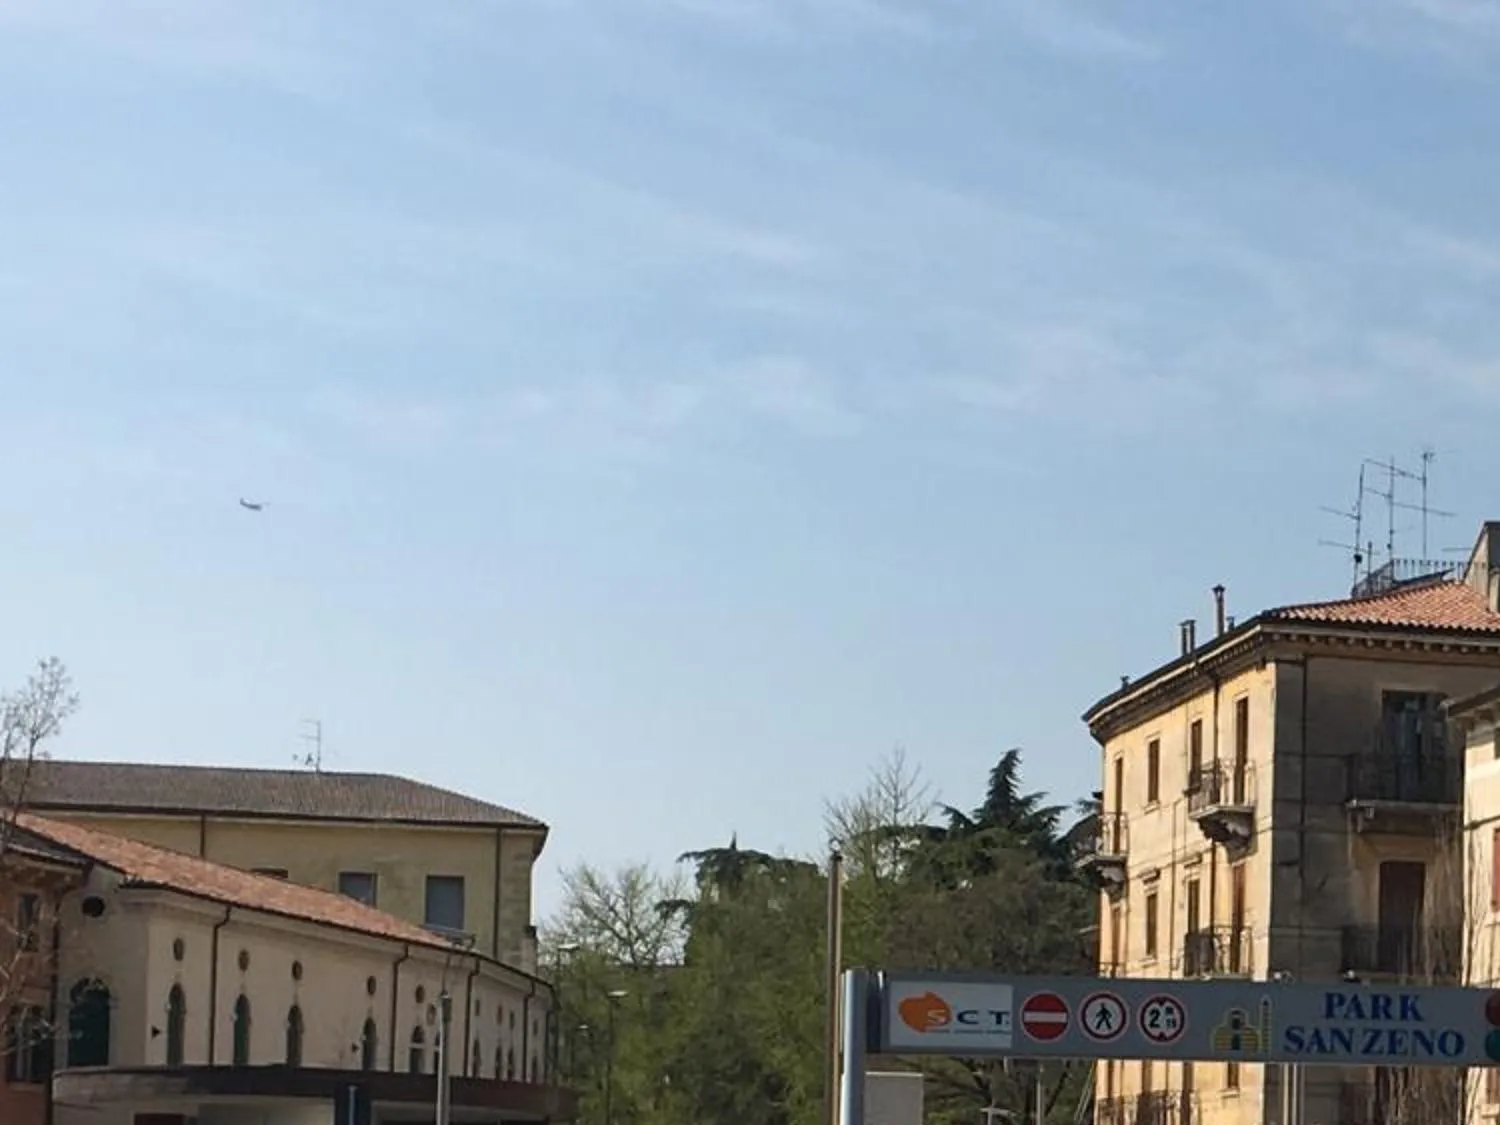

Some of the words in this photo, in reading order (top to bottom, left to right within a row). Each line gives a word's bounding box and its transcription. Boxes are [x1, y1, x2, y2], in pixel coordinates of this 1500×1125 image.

[1325, 993, 1423, 1021] PARK
[1284, 1025, 1355, 1053] SAN
[1362, 1028, 1465, 1056] ZENO
